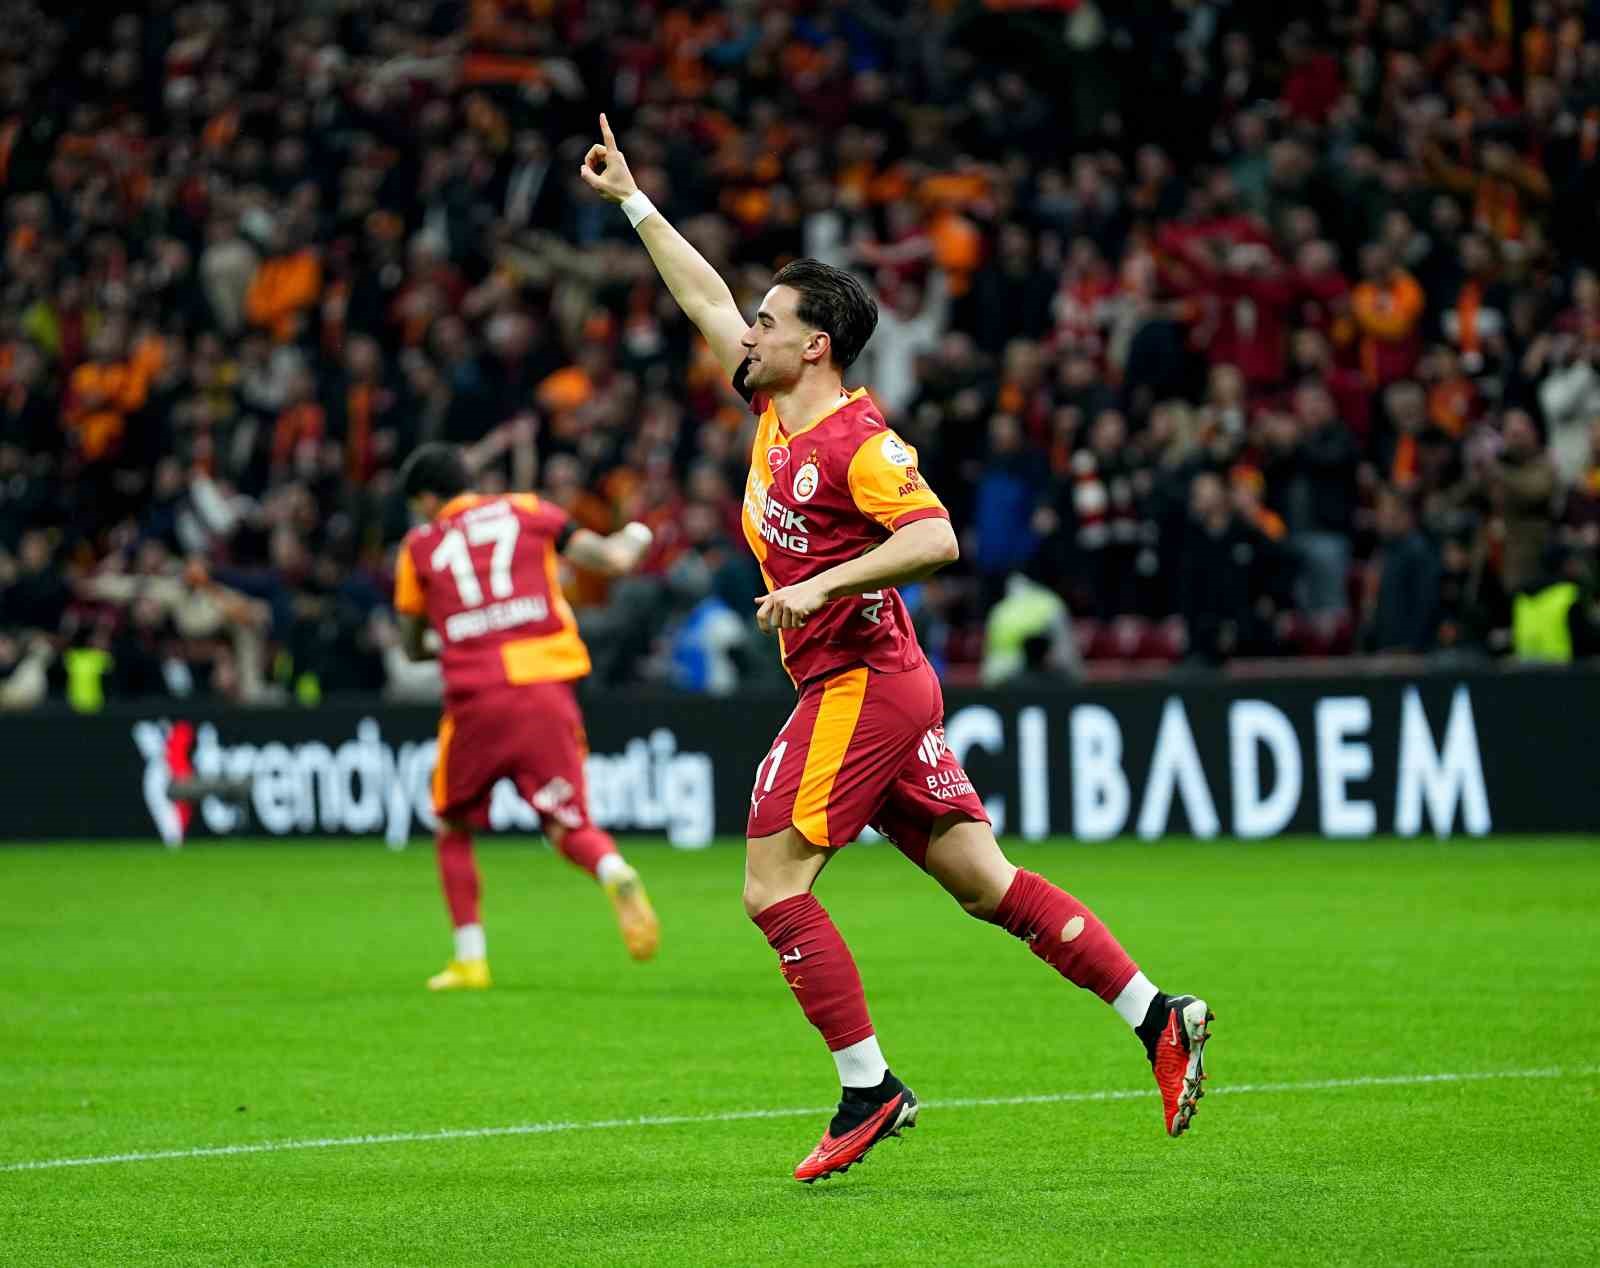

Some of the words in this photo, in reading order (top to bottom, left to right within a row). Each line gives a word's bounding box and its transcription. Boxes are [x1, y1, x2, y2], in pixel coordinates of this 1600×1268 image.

[431, 514, 519, 607] 17
[194, 717, 447, 850] trendyo
[942, 682, 1492, 840] CIBADEM
